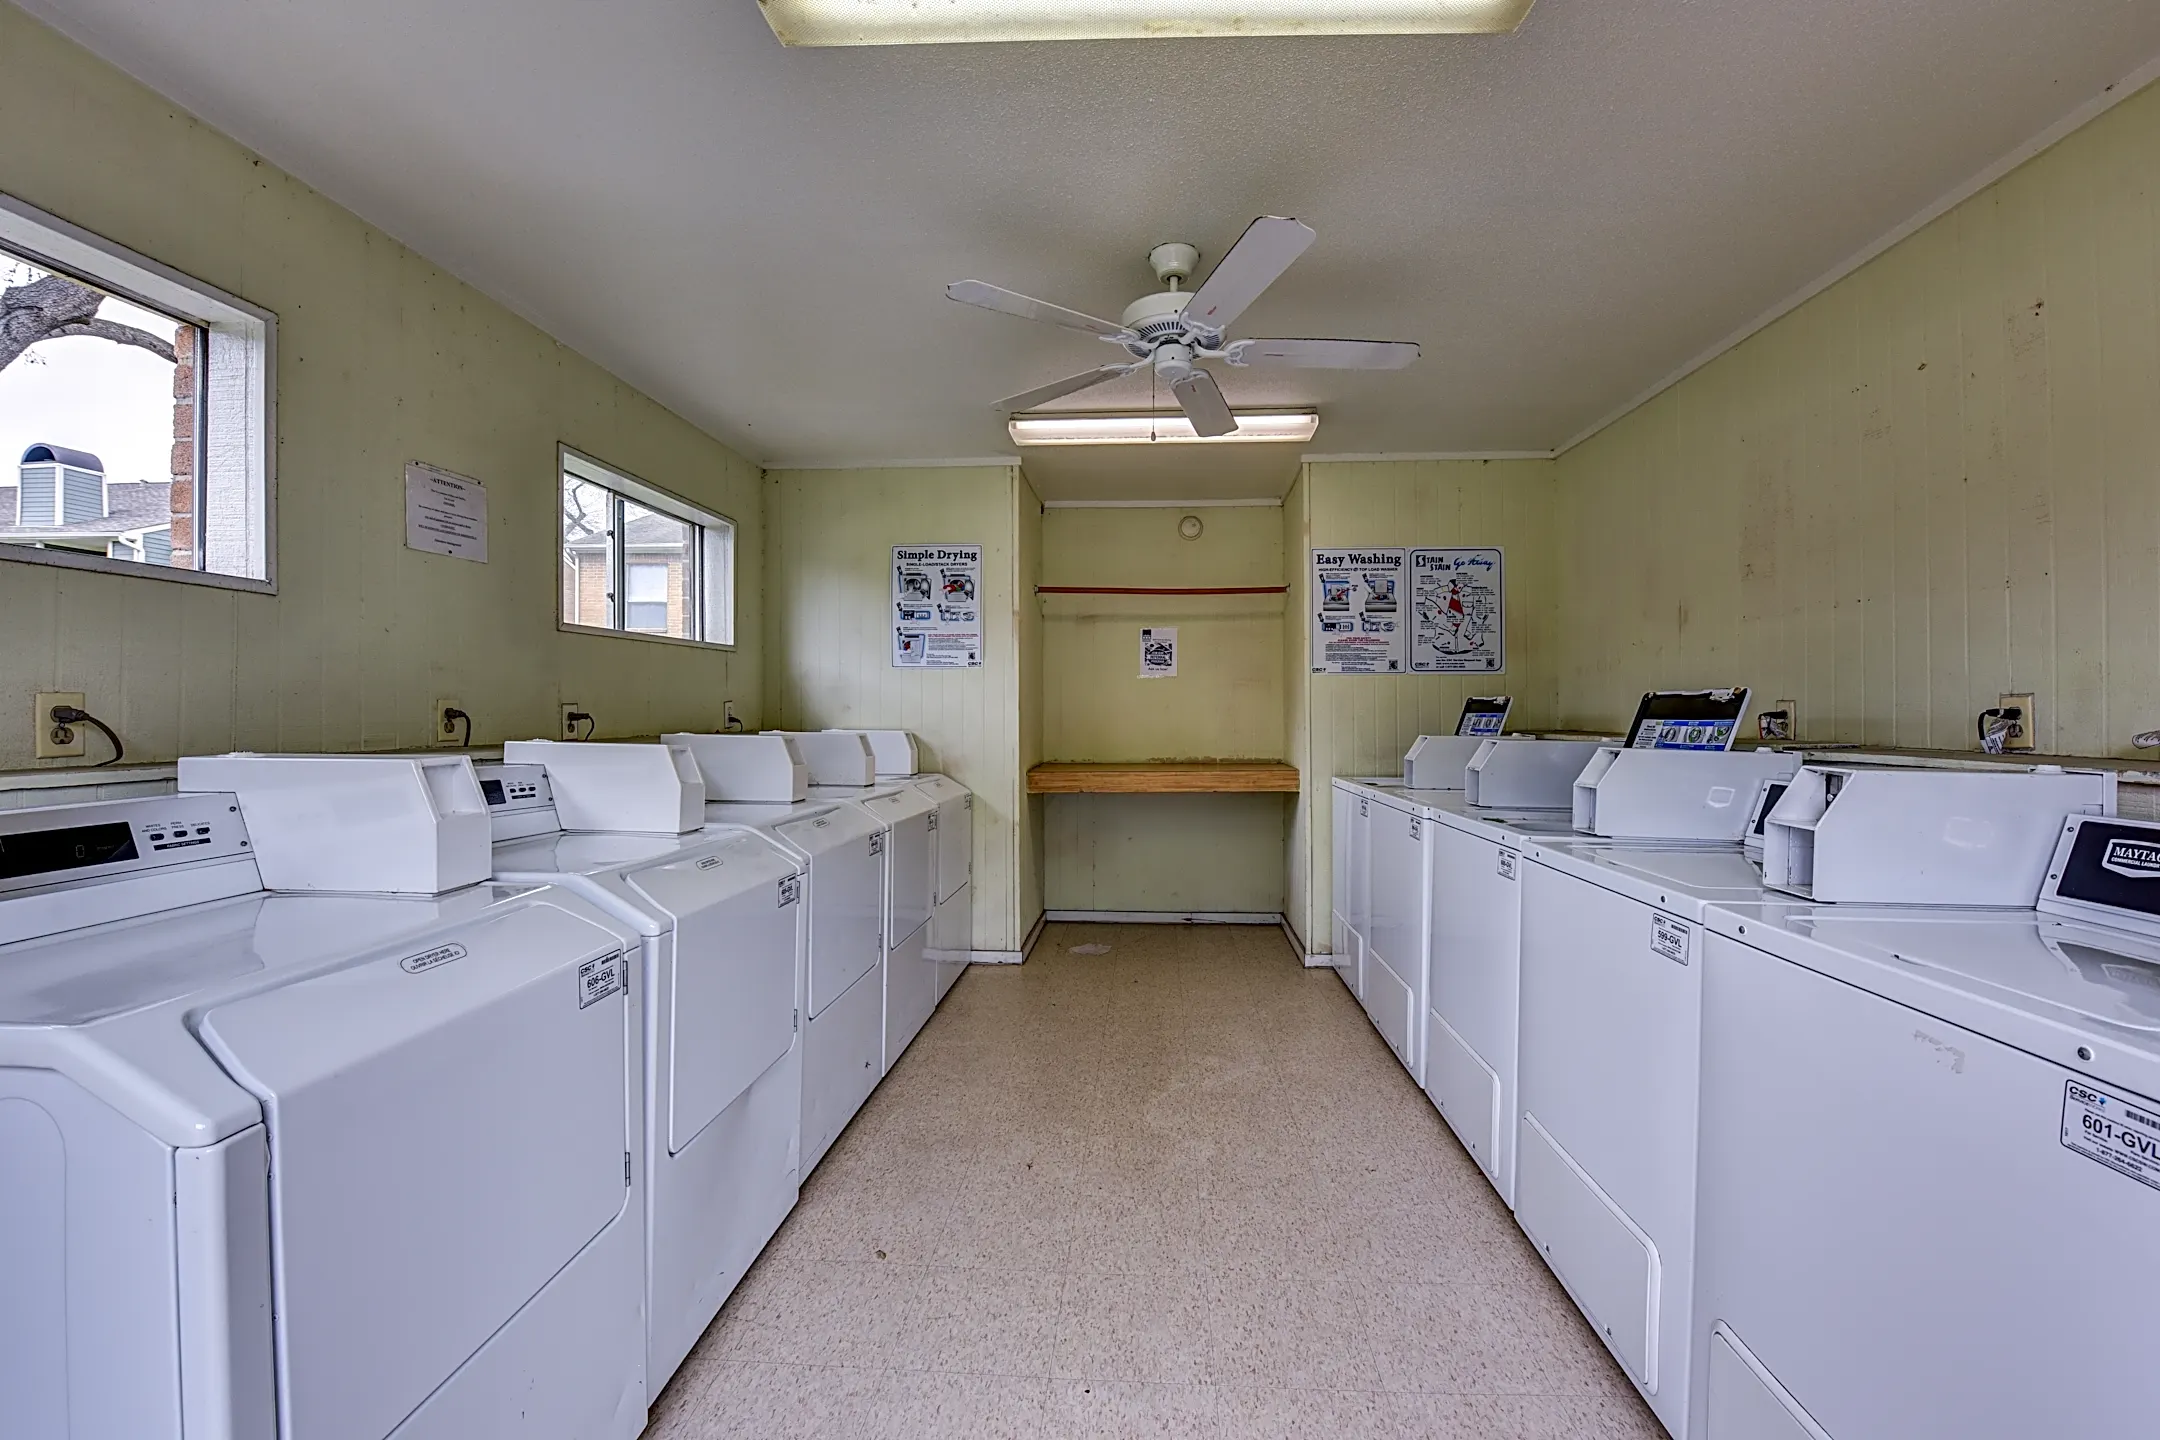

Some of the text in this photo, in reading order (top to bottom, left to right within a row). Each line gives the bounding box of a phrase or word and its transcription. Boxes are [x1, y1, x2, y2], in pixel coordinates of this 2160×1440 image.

[897, 549, 978, 562] Simple Drying
[1316, 552, 1402, 567] Easy Washing
[1429, 563, 1451, 571] STAIN
[1453, 556, 1465, 571] Go
[580, 964, 592, 975] CSC
[2069, 1086, 2098, 1102] CSC
[2082, 1114, 2160, 1161] 601-GVL
